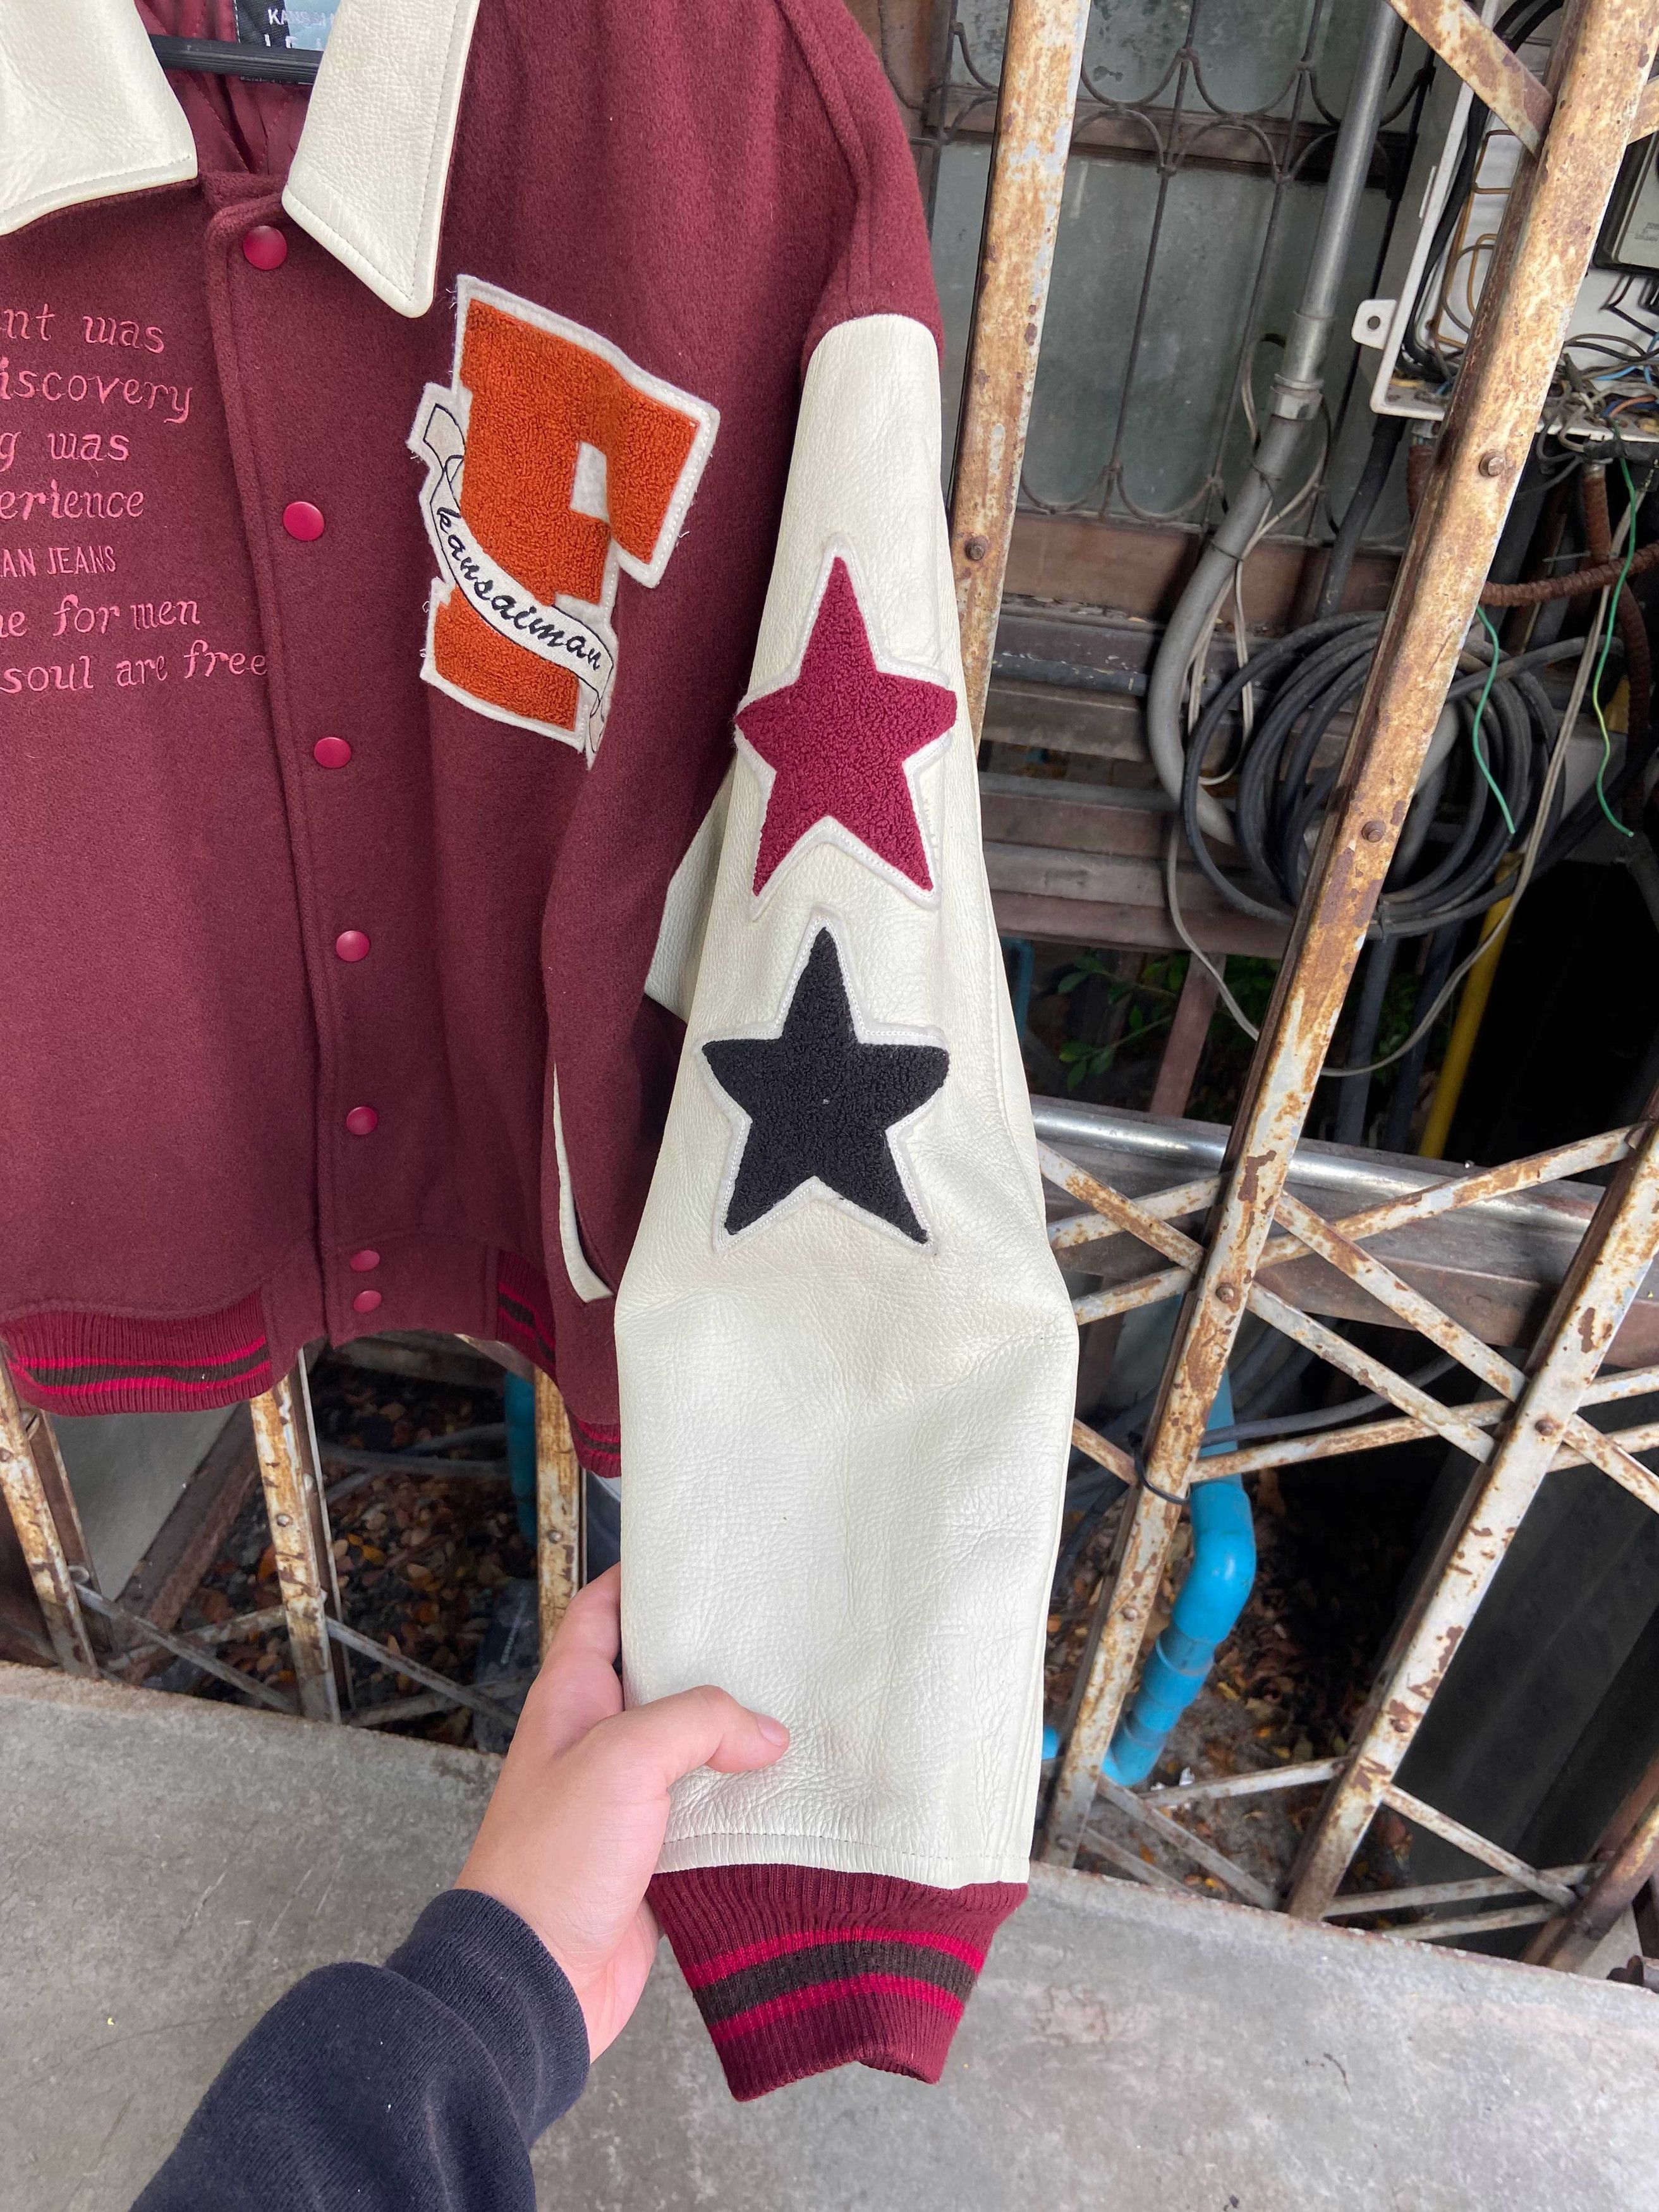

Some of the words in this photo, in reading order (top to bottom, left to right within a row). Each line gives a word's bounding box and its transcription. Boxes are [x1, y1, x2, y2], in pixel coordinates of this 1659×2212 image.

[4, 303, 55, 341] nt
[83, 316, 165, 353] was
[47, 432, 129, 461] was
[0, 479, 144, 520] erience
[3, 549, 37, 578] AN
[47, 545, 116, 574] JEANS
[52, 594, 120, 636] for
[130, 600, 201, 630] men
[0, 655, 94, 694] soul
[116, 655, 168, 687] are
[183, 639, 267, 679] free
